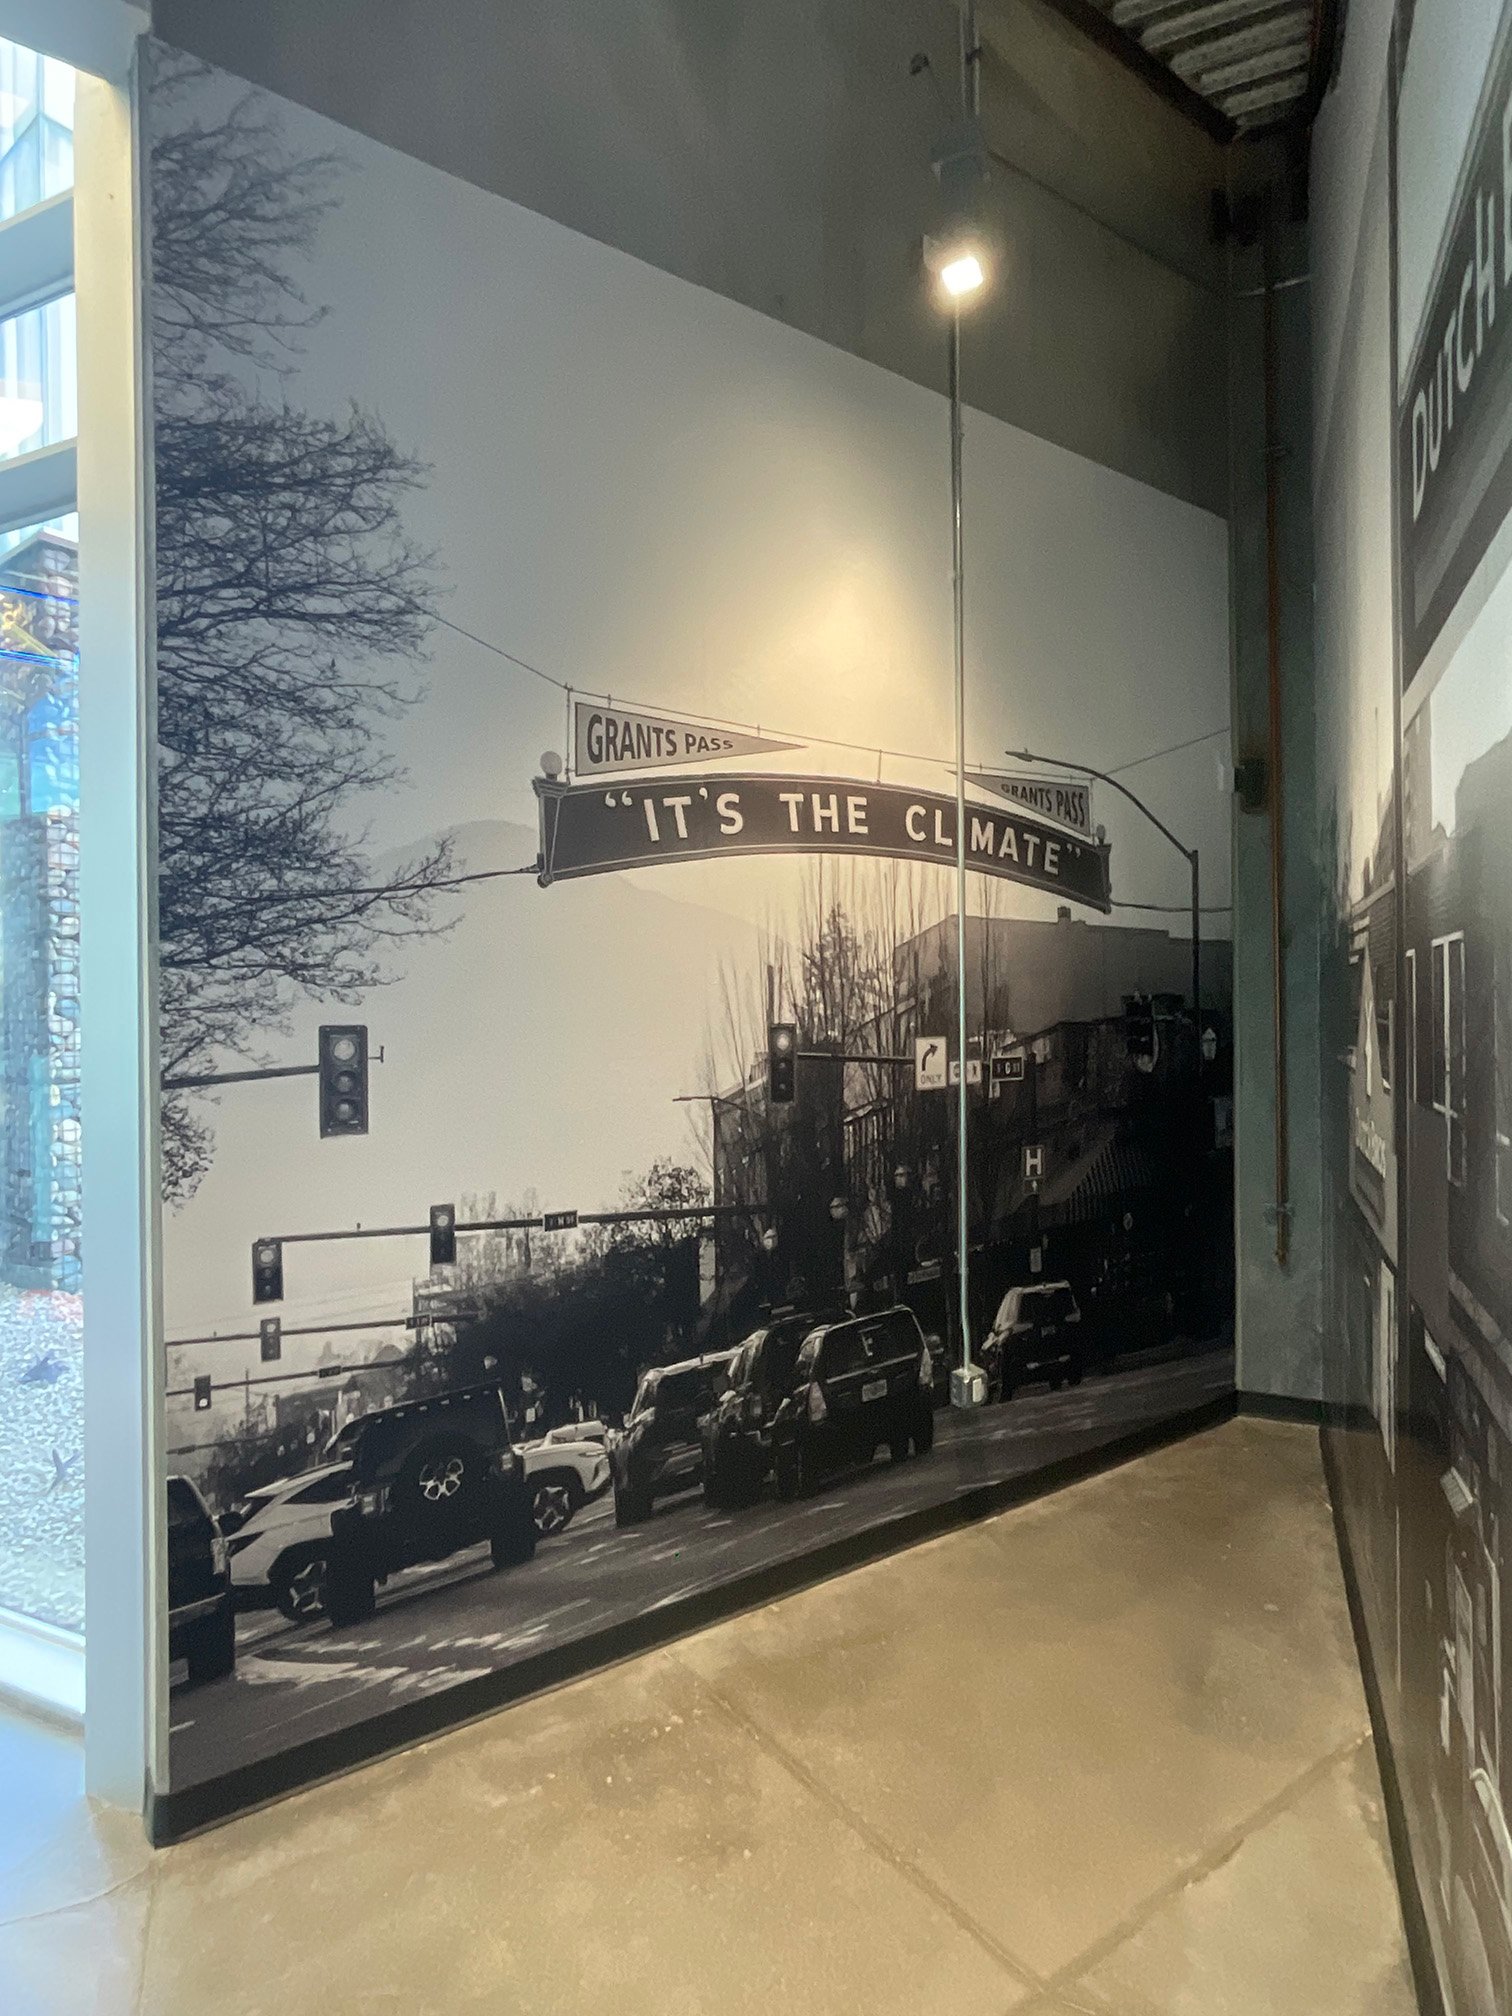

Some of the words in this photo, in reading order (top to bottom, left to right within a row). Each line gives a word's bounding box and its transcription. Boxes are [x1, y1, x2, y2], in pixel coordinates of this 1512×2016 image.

[1412, 186, 1495, 523] DUTCH
[587, 713, 677, 764] GRANTS
[685, 733, 734, 754] PASS
[1000, 782, 1052, 813] GRANTS
[1056, 788, 1086, 828] PASS
[604, 787, 744, 842] "IT'S
[779, 793, 869, 834] THE
[905, 804, 1081, 876] CLMATE"
[920, 1074, 942, 1085] ONLY
[1025, 1148, 1042, 1177] H
